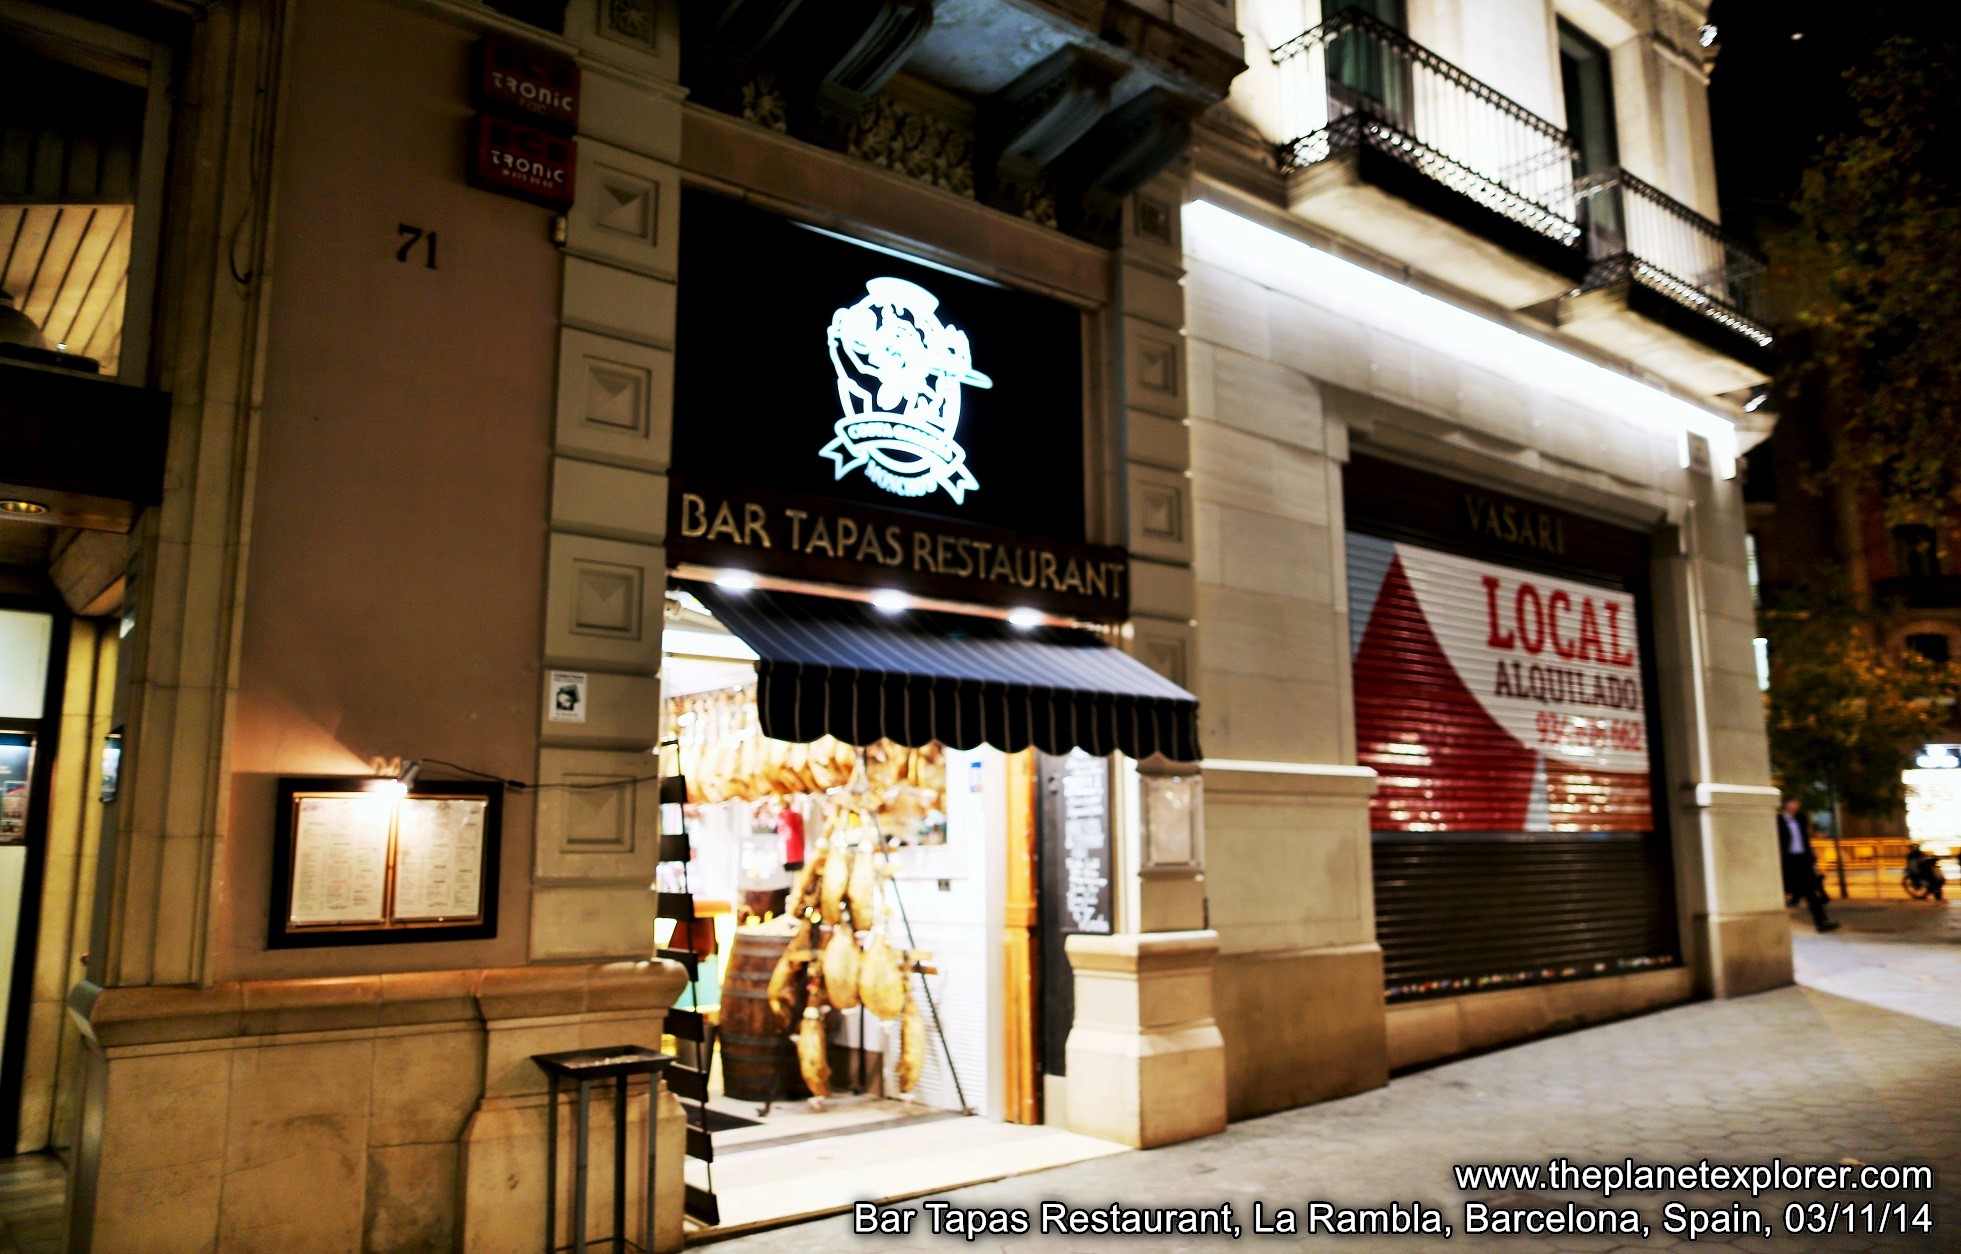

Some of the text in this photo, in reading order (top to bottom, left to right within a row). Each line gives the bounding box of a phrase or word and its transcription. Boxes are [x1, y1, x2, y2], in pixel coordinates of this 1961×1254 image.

[396, 223, 438, 270] 71
[681, 493, 1124, 599] BAR TAPAS RESTAURANT
[1464, 493, 1567, 556] VASARI
[1480, 574, 1634, 668] LOCAL
[1495, 658, 1638, 710] ALQUILADO
